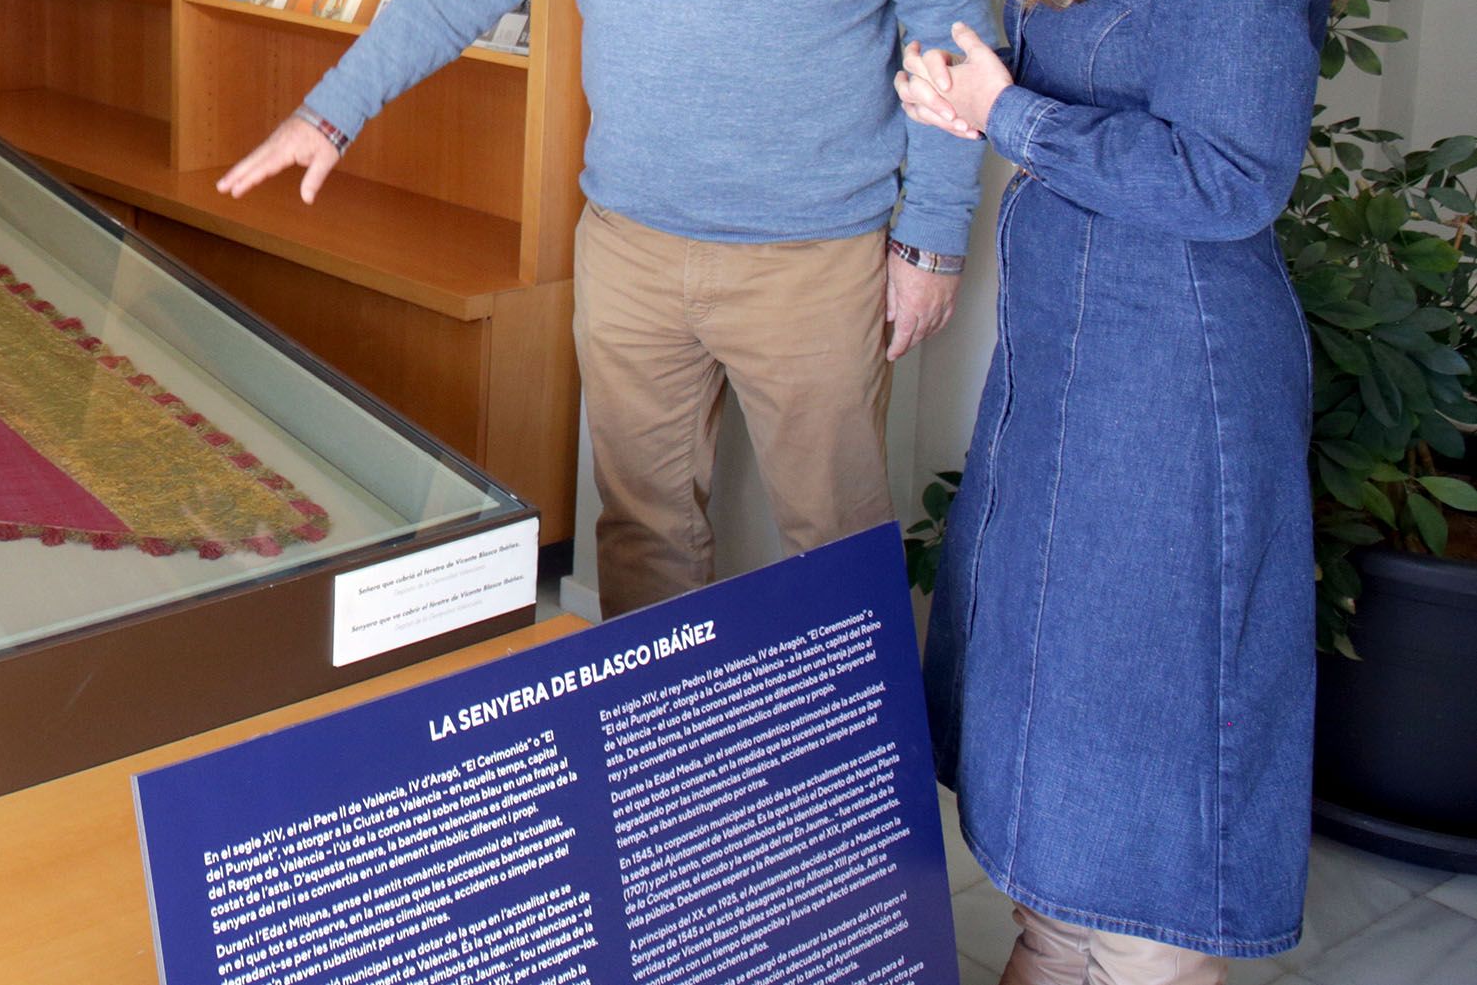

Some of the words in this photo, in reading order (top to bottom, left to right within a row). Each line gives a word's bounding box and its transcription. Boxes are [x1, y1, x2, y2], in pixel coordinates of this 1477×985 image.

[429, 715, 456, 742] LA
[458, 682, 550, 731] SENYERA
[551, 671, 578, 698] DE
[579, 645, 652, 688] BLASCO
[653, 620, 717, 660] IBÁÑEZ
[599, 709, 612, 722] En
[611, 704, 621, 717] el
[621, 698, 641, 714] siglo
[640, 690, 659, 706] XIV,
[659, 686, 668, 699] el
[667, 683, 681, 695] rey
[681, 674, 706, 690] Pedro
[712, 666, 724, 678] de
[757, 647, 767, 660] IV
[767, 645, 778, 657] de
[778, 635, 807, 653] Aragón,
[866, 609, 873, 618] o
[203, 851, 219, 866] En
[220, 844, 231, 860] el
[232, 836, 262, 856] segle
[261, 826, 286, 846] XIV,
[286, 821, 297, 837] el
[312, 810, 338, 828] Pere
[347, 801, 362, 815] de
[361, 786, 408, 809] València,
[407, 778, 419, 794] IV
[532, 737, 540, 747] o
[610, 782, 645, 803] Durante
[644, 778, 653, 789] la
[653, 767, 675, 786] Edad
[675, 758, 703, 776] Media,
[703, 752, 715, 765] sin
[715, 747, 724, 760] el
[723, 737, 753, 757] sentido
[752, 722, 790, 744] romántico
[789, 702, 831, 731] patrimonial
[830, 700, 841, 711] de
[840, 697, 848, 707] la
[848, 680, 886, 704] actualidad,
[212, 909, 257, 934] Senyera
[257, 899, 276, 918] del
[296, 890, 310, 903] es
[359, 866, 373, 880] en
[373, 861, 388, 874] un
[388, 843, 429, 869] element
[429, 829, 470, 853] simbòlic
[469, 813, 507, 837] diferent
[511, 801, 539, 823] propi.
[215, 933, 255, 959] Durant
[288, 907, 331, 931] Mitjana,
[331, 895, 361, 915] sense
[361, 887, 372, 903] el
[372, 877, 402, 899] sentit
[402, 861, 446, 887] romàntic
[446, 838, 500, 872] patrimonial
[499, 835, 513, 848] de
